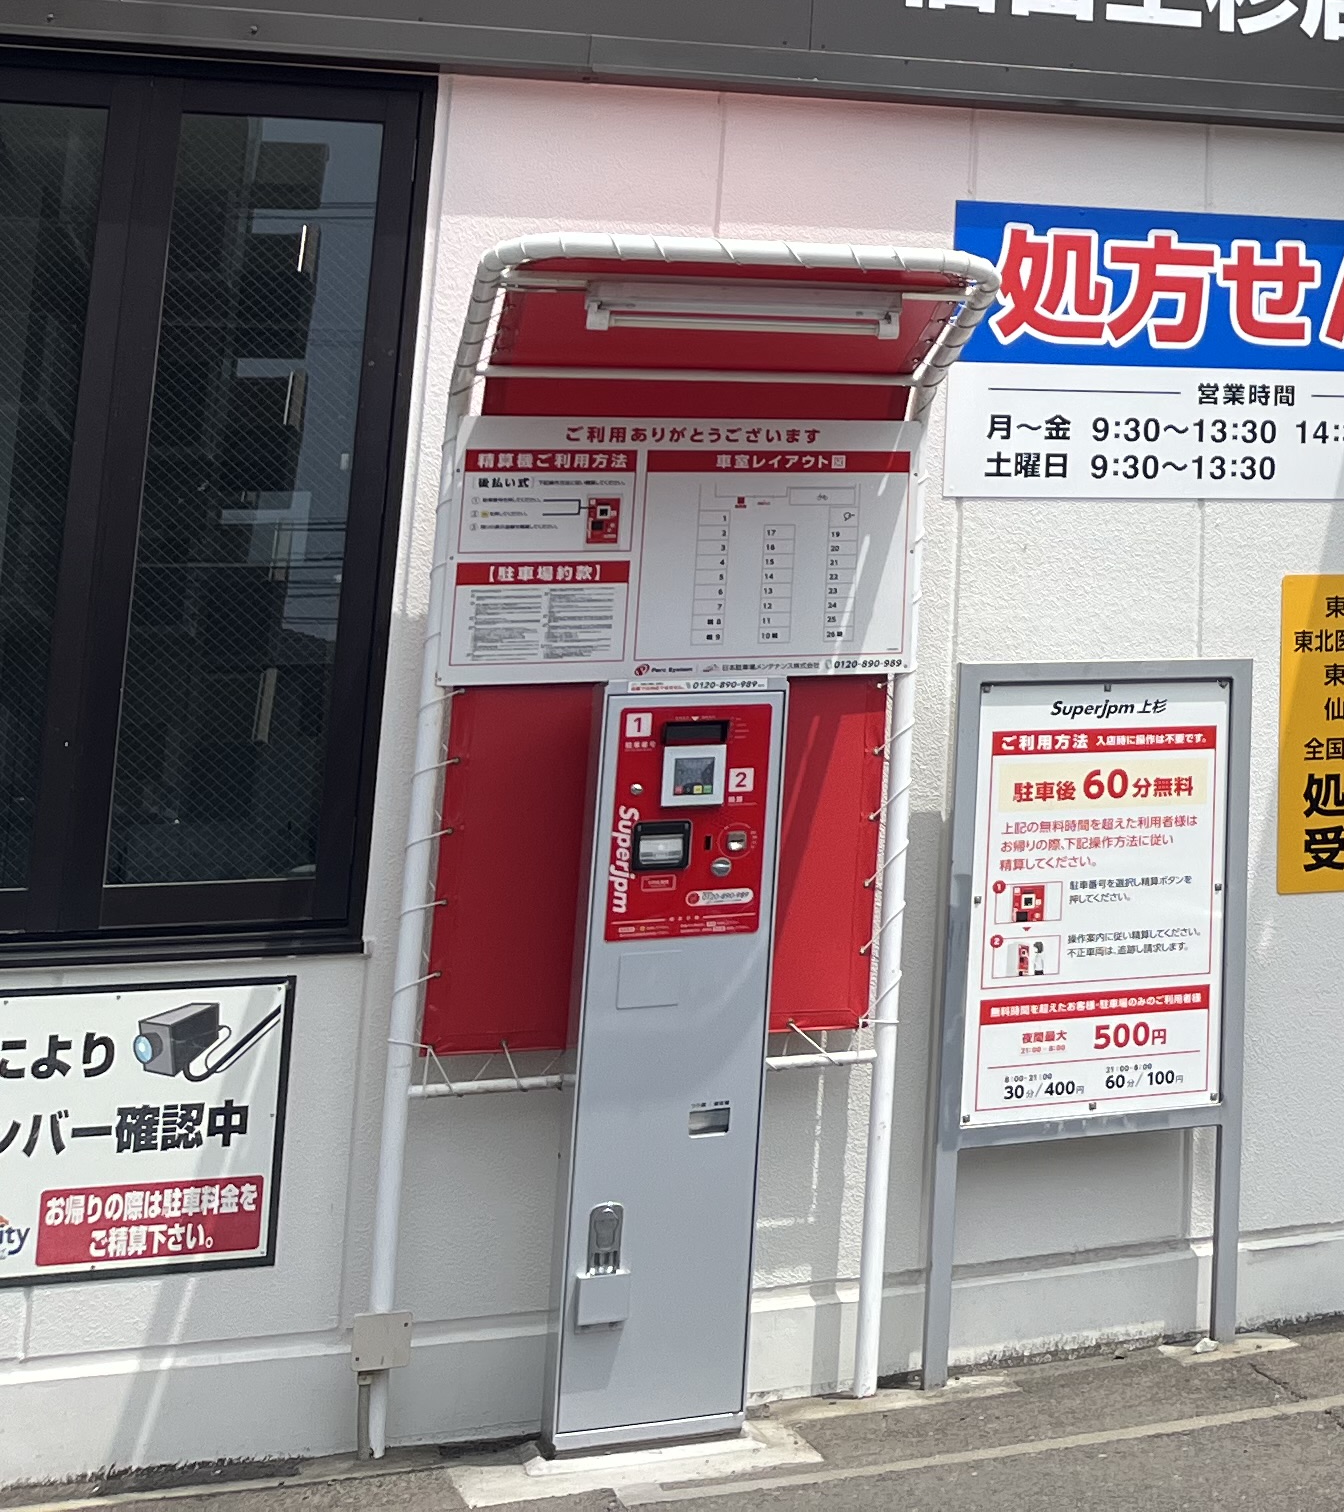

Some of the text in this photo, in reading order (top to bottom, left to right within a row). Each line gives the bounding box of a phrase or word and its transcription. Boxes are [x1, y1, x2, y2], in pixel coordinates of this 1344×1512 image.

[1197, 382, 1296, 407] 営業時間
[565, 425, 821, 444] ご利用ありがとうございます
[1091, 418, 1278, 444] 9:30〜13:30
[477, 453, 628, 469] 精算機ご利用方法
[985, 452, 1069, 479] 土曜日
[1090, 455, 1277, 480] 9:30〜13:30
[834, 659, 902, 669] 0120-890-989
[1050, 698, 1168, 719] Superjpm 上杉
[633, 717, 641, 733] 1
[1001, 733, 1207, 751] ご利用方法 入店時に操作は不要です。
[735, 772, 747, 788] 2
[1001, 814, 1198, 835] 上記の無料時間を超えた利用者様は
[1000, 833, 1174, 853] お帰りの際、下記操作方法に従い
[609, 805, 640, 914] Superjpm
[999, 855, 1097, 871] 精算してください。
[1094, 1021, 1167, 1050] 500円
[45, 1182, 259, 1226] お帰りの際は駐車料金を
[89, 1221, 214, 1257] ご精算下さい。
